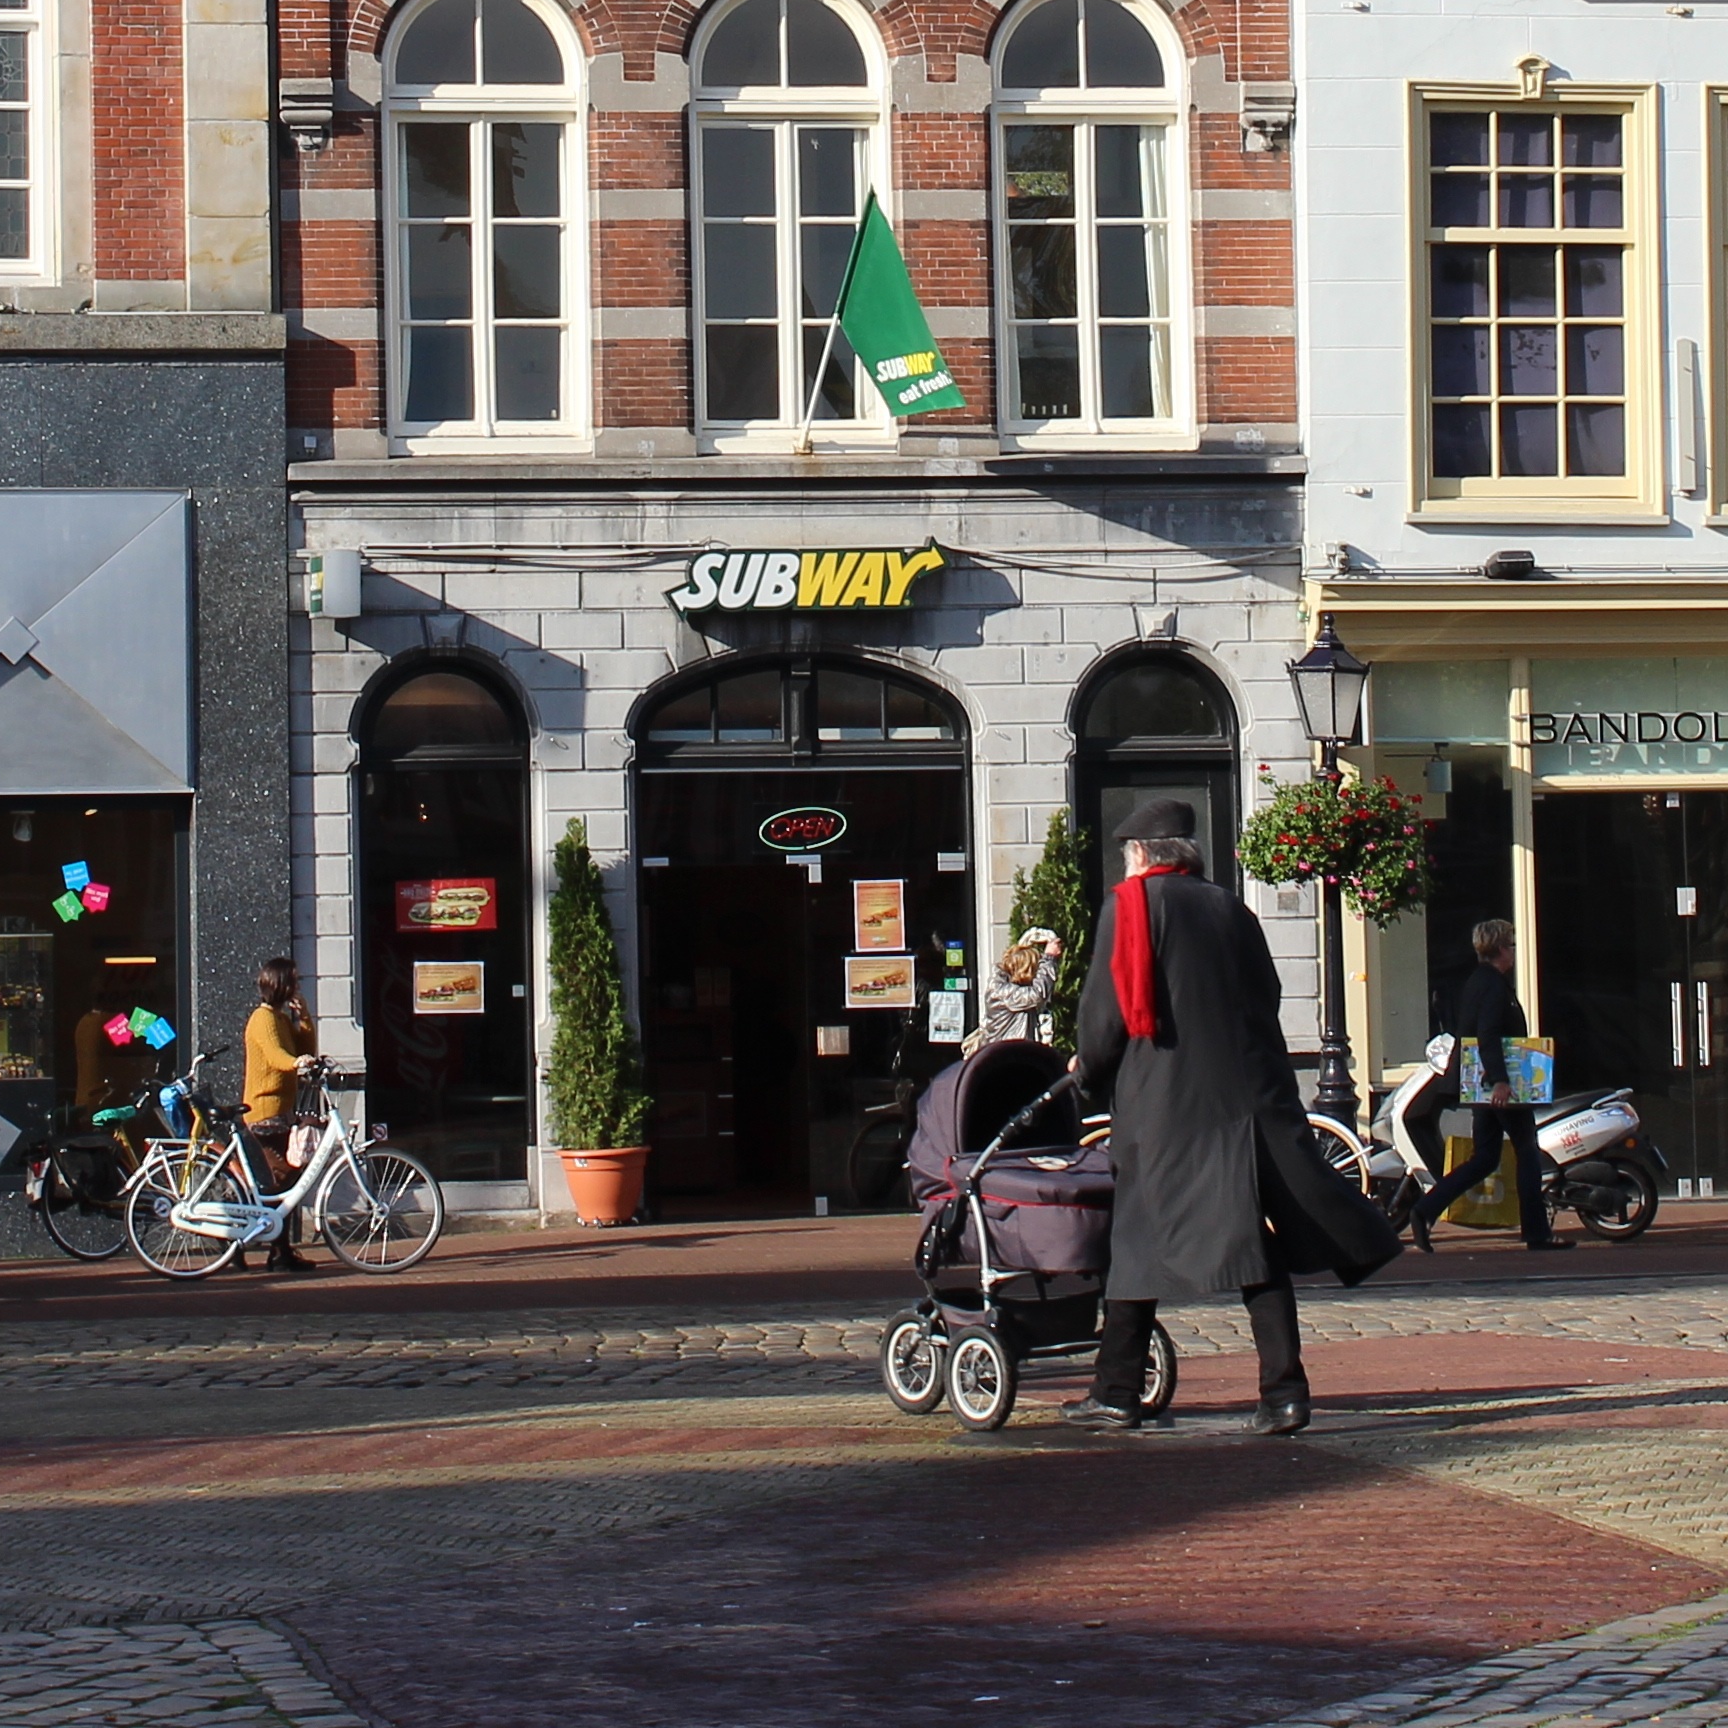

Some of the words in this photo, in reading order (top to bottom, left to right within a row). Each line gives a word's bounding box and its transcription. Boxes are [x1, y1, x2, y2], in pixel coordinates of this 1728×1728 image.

[876, 351, 936, 383] SUBWAY
[898, 382, 923, 405] eat
[671, 546, 945, 612] SUBWAY
[770, 816, 835, 840] OPEN
